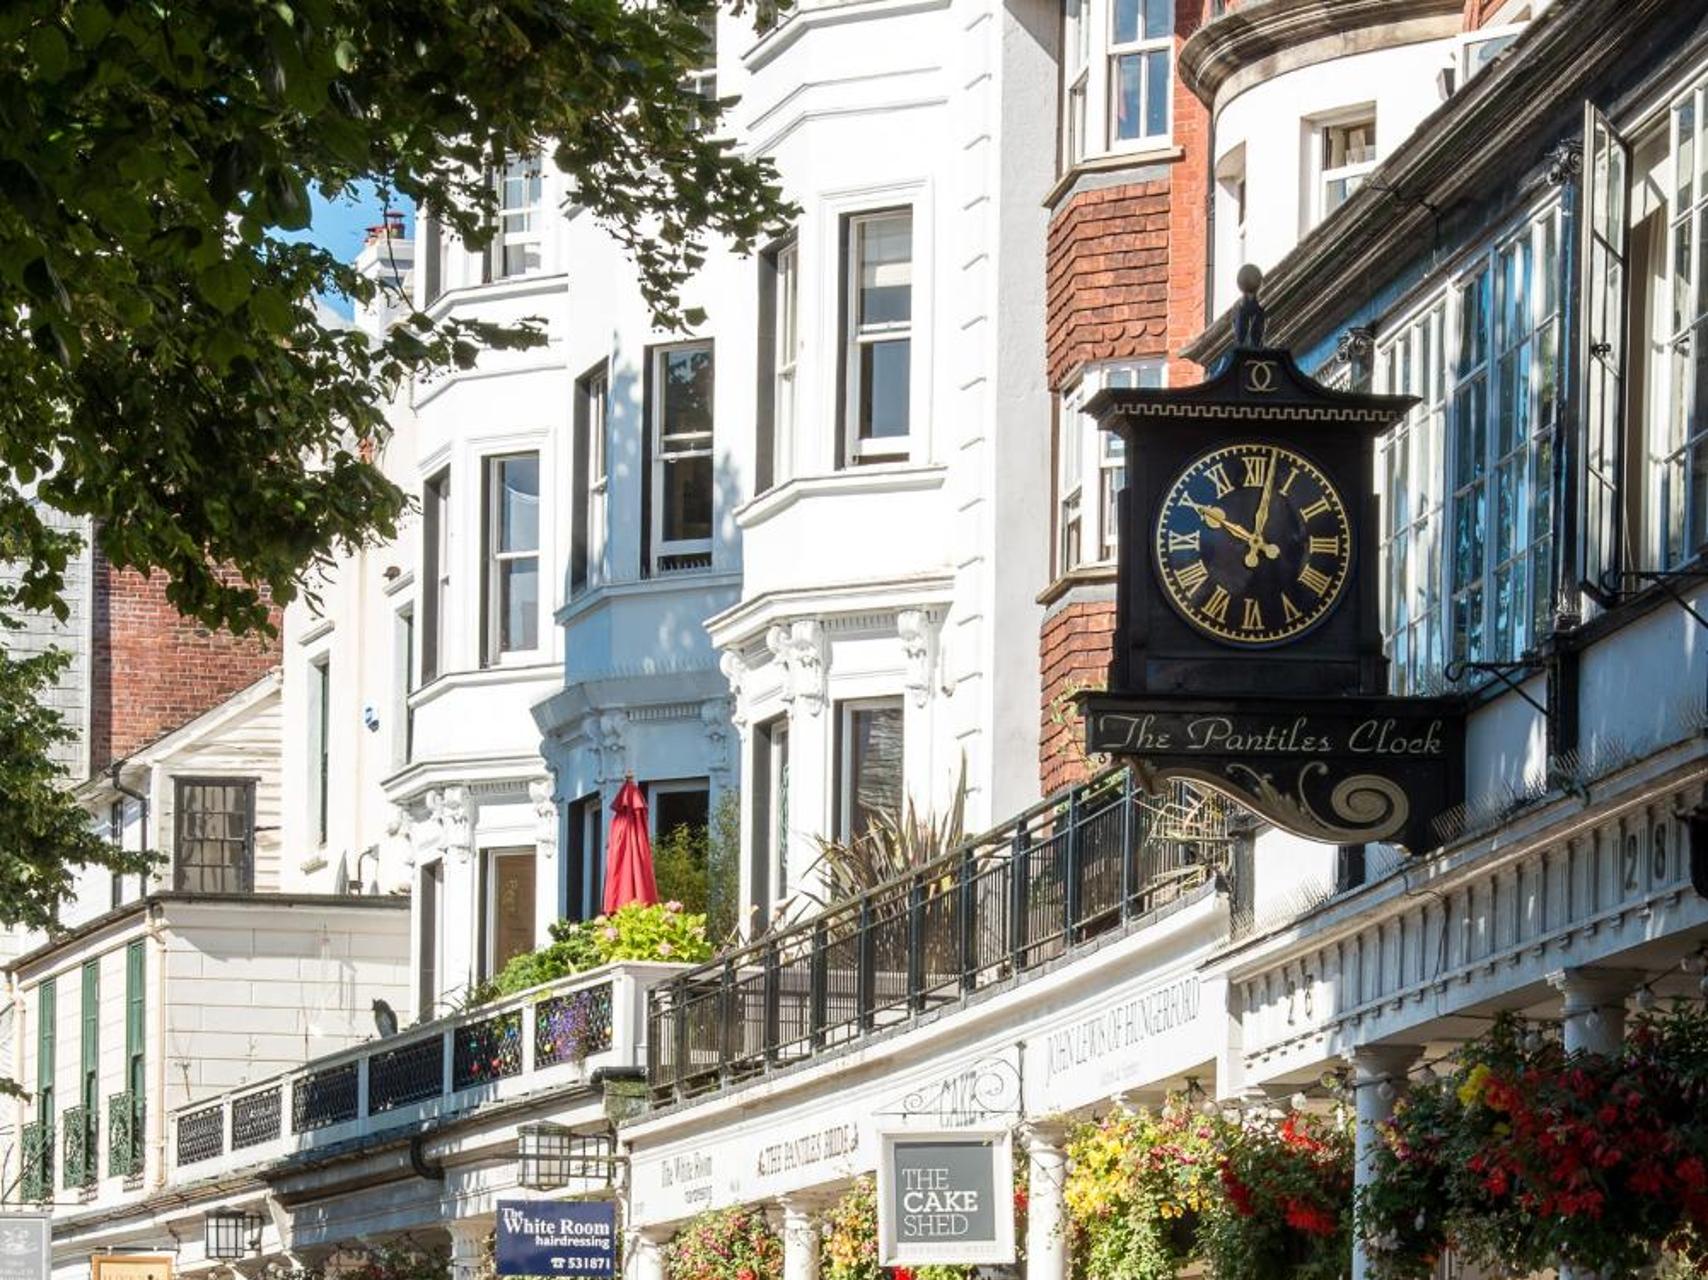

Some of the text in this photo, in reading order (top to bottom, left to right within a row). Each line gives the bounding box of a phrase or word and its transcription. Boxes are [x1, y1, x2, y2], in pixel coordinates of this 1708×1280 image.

[1204, 463, 1235, 499] XI
[1242, 457, 1267, 487] XII
[1300, 496, 1331, 523] II
[1169, 530, 1200, 553] IX
[1310, 536, 1339, 556] III
[1242, 598, 1265, 630] VI
[1281, 592, 1302, 623] V
[1099, 713, 1442, 754] The Pantiles Clock
[902, 1168, 950, 1191] THE
[501, 1207, 524, 1220] The
[903, 1191, 979, 1213] CAKE
[503, 1217, 610, 1235] White Room
[903, 1213, 969, 1236] SHED
[535, 1235, 610, 1250] hairdressing
[567, 1257, 611, 1270] 531871
